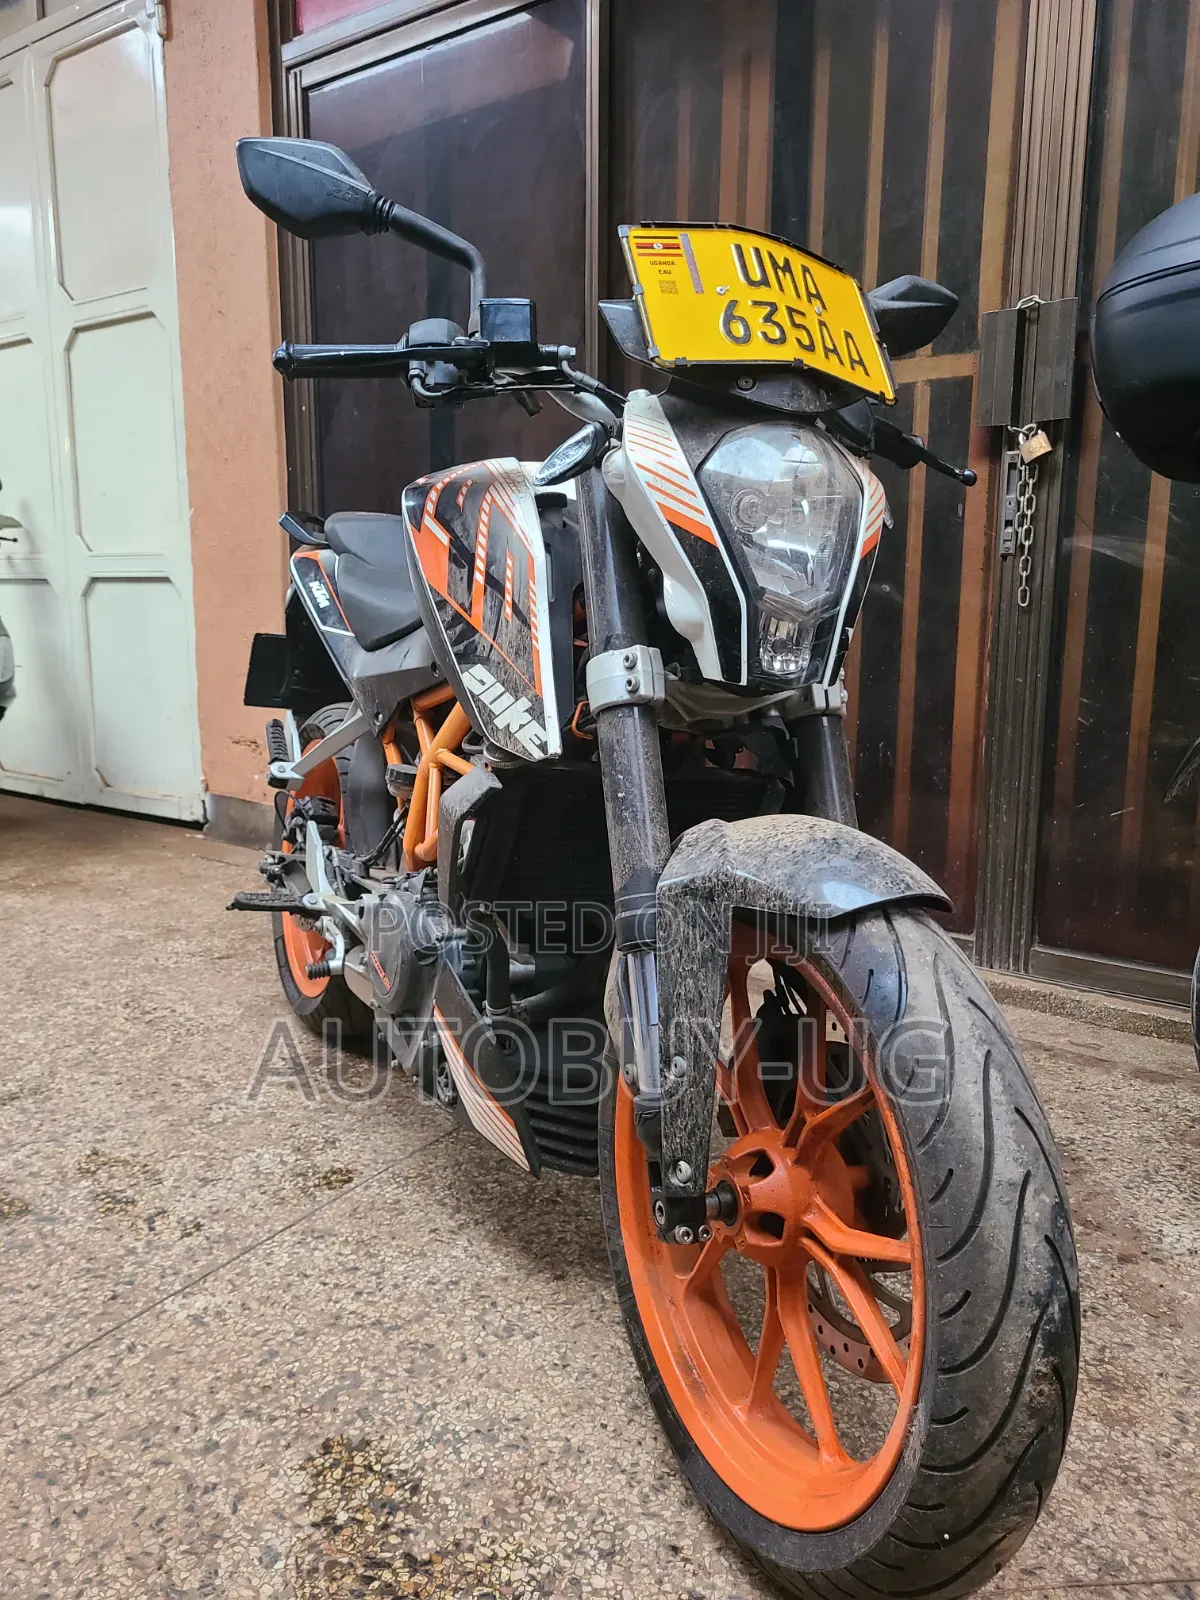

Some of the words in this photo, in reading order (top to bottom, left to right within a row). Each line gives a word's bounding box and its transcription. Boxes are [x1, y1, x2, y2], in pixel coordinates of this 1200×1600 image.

[730, 243, 828, 312] UMA
[719, 299, 871, 378] 635AA
[308, 580, 331, 609] KTM
[461, 663, 548, 760] DUKE
